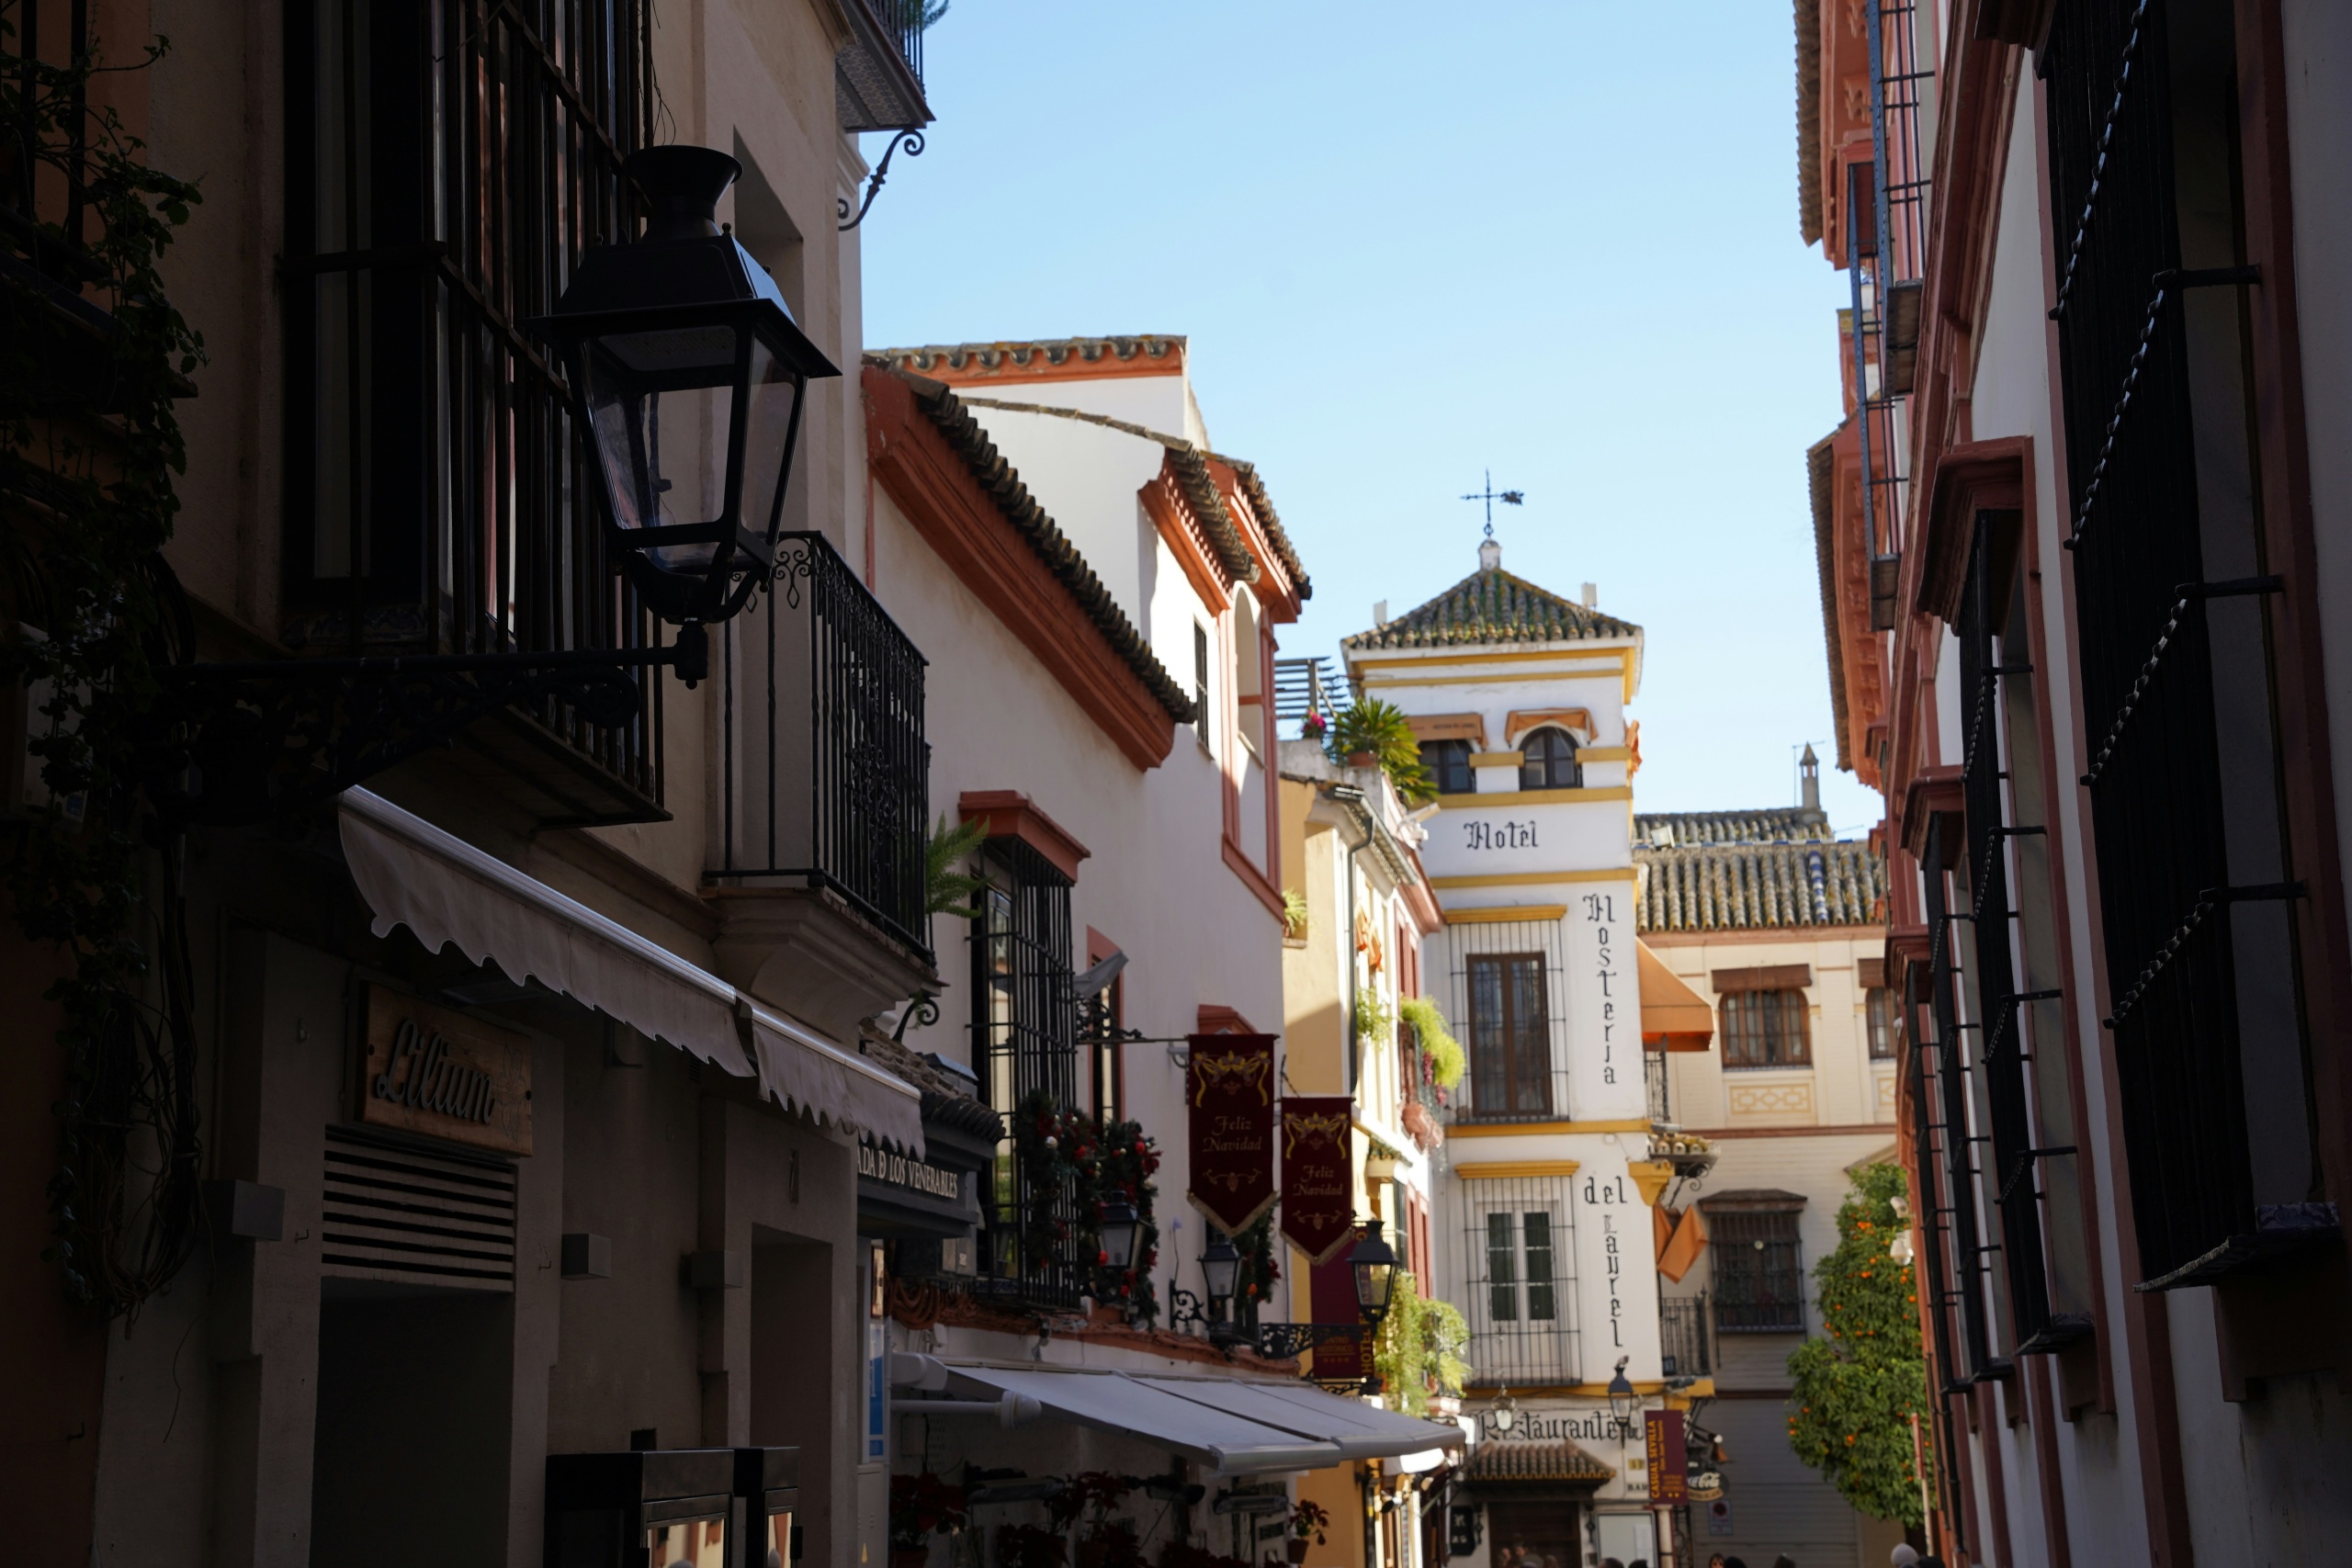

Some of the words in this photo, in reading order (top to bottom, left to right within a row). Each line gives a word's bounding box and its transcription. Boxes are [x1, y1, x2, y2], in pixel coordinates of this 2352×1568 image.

[1464, 820, 1539, 850] Hotel
[1582, 894, 1617, 1085] Hosteria
[375, 1018, 496, 1125] Lilium
[1211, 1115, 1252, 1135] Feliz
[1202, 1136, 1262, 1153] Navidad
[888, 1155, 907, 1186] LOS
[907, 1160, 958, 1200] VENERABLES
[1292, 1183, 1343, 1197] Navidad
[1299, 1165, 1335, 1182] Feliz
[1584, 1176, 1627, 1205] del
[1602, 1214, 1623, 1348] Laurel
[1360, 1328, 1373, 1374] HOTEL
[1470, 1410, 1619, 1441] Rstaurante
[1646, 1420, 1657, 1459] SEVILLA
[1648, 1461, 1660, 1499] CASUAL
